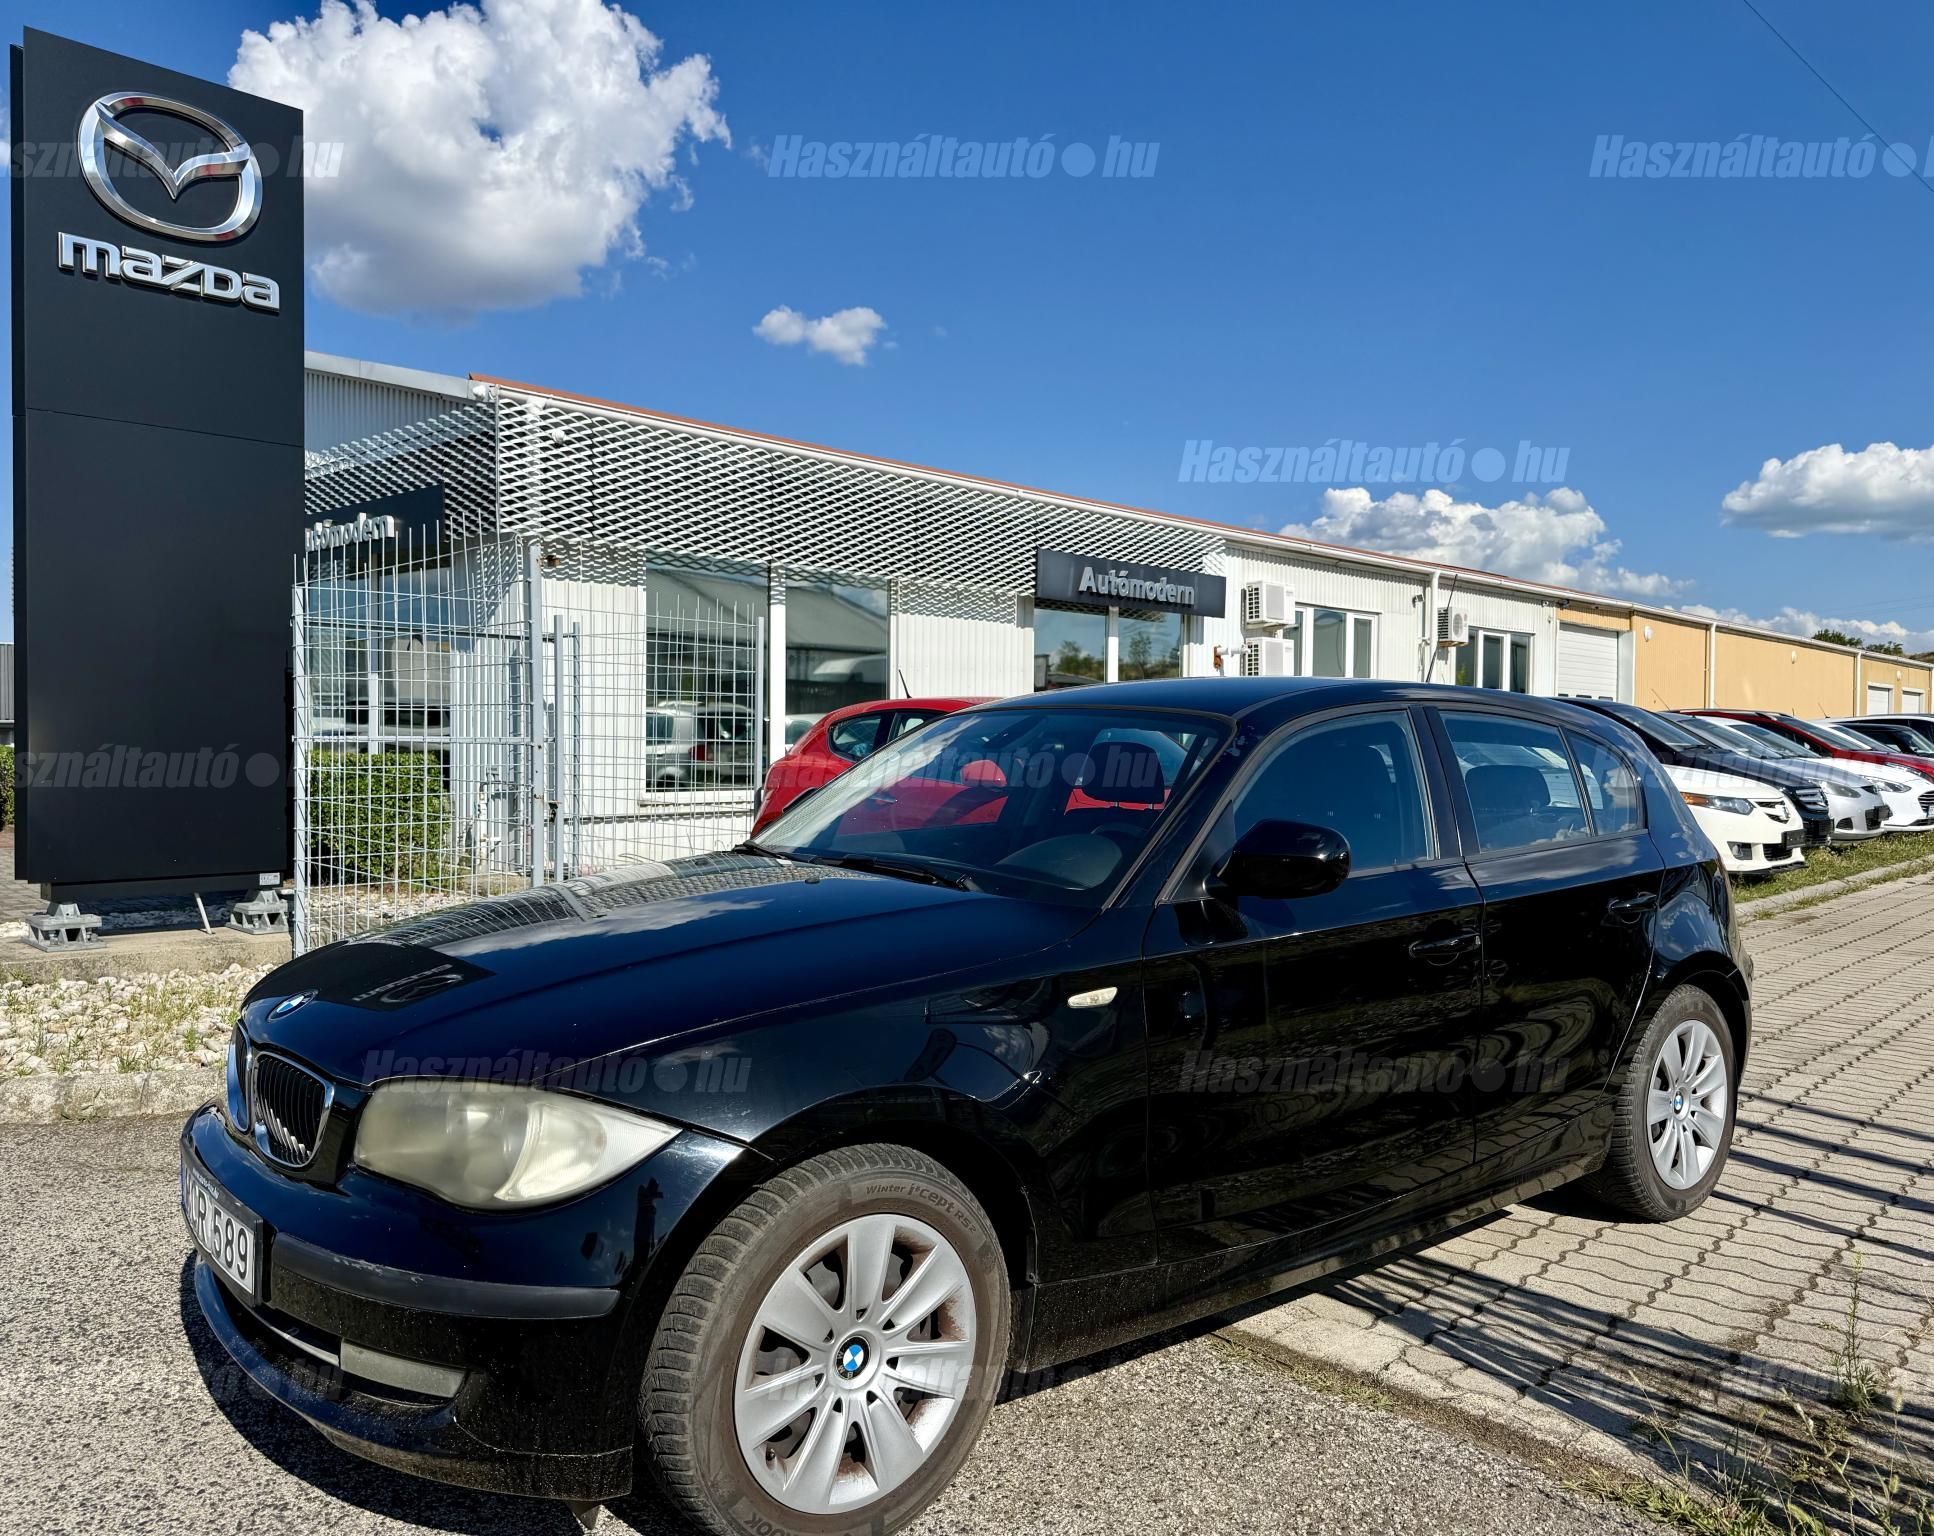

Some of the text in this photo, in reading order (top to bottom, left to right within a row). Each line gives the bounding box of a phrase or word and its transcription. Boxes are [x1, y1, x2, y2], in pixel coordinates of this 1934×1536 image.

[304, 512, 395, 551] utómodern
[1078, 566, 1195, 605] Autómodern
[866, 1184, 906, 1195] Winter
[954, 1211, 977, 1233] RS2
